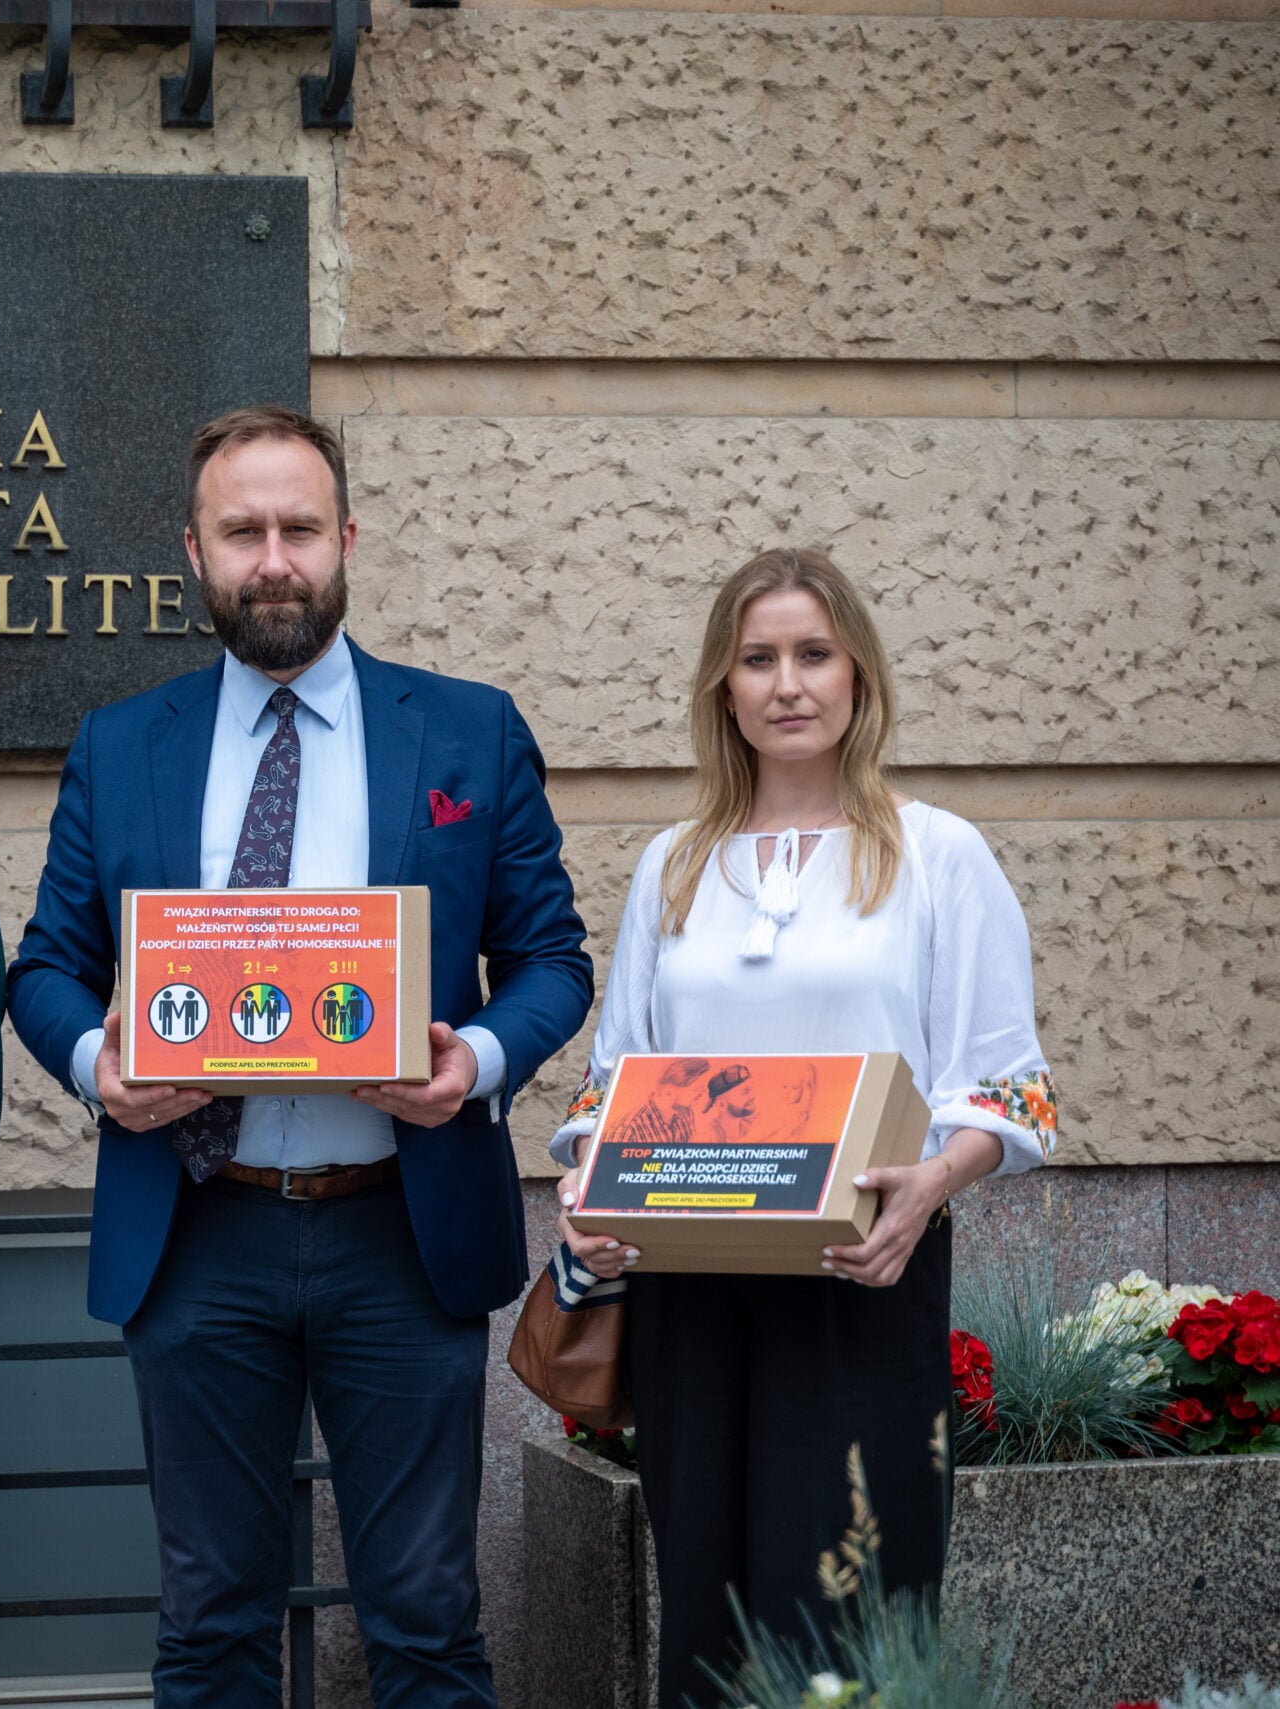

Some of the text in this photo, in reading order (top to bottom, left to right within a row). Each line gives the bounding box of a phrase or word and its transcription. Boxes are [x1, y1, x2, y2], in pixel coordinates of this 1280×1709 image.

[163, 908, 361, 919] ZWIĄZKI PARTNERSKIE TO DROGA DO:
[176, 922, 359, 933] MAŁŻEŃSTW OSÓB TEJ SAMEJ PŁCI!
[139, 940, 185, 949] ADOPCJI
[188, 940, 220, 949] DZIECI
[223, 940, 255, 949] PRZEZ
[258, 940, 286, 949] PARY
[287, 940, 382, 949] HOMOSEKSUALNE
[167, 963, 175, 974] 1
[244, 962, 252, 974] 2
[329, 962, 338, 973] 3
[621, 1149, 808, 1160] STOP ZWIĄZKOM PARTNERSKIM!
[642, 1163, 778, 1173] NIE DLA ADOPCJI DZIECI
[618, 1173, 797, 1184] PRZEZ PARY HOMOSEKSUALNE!
